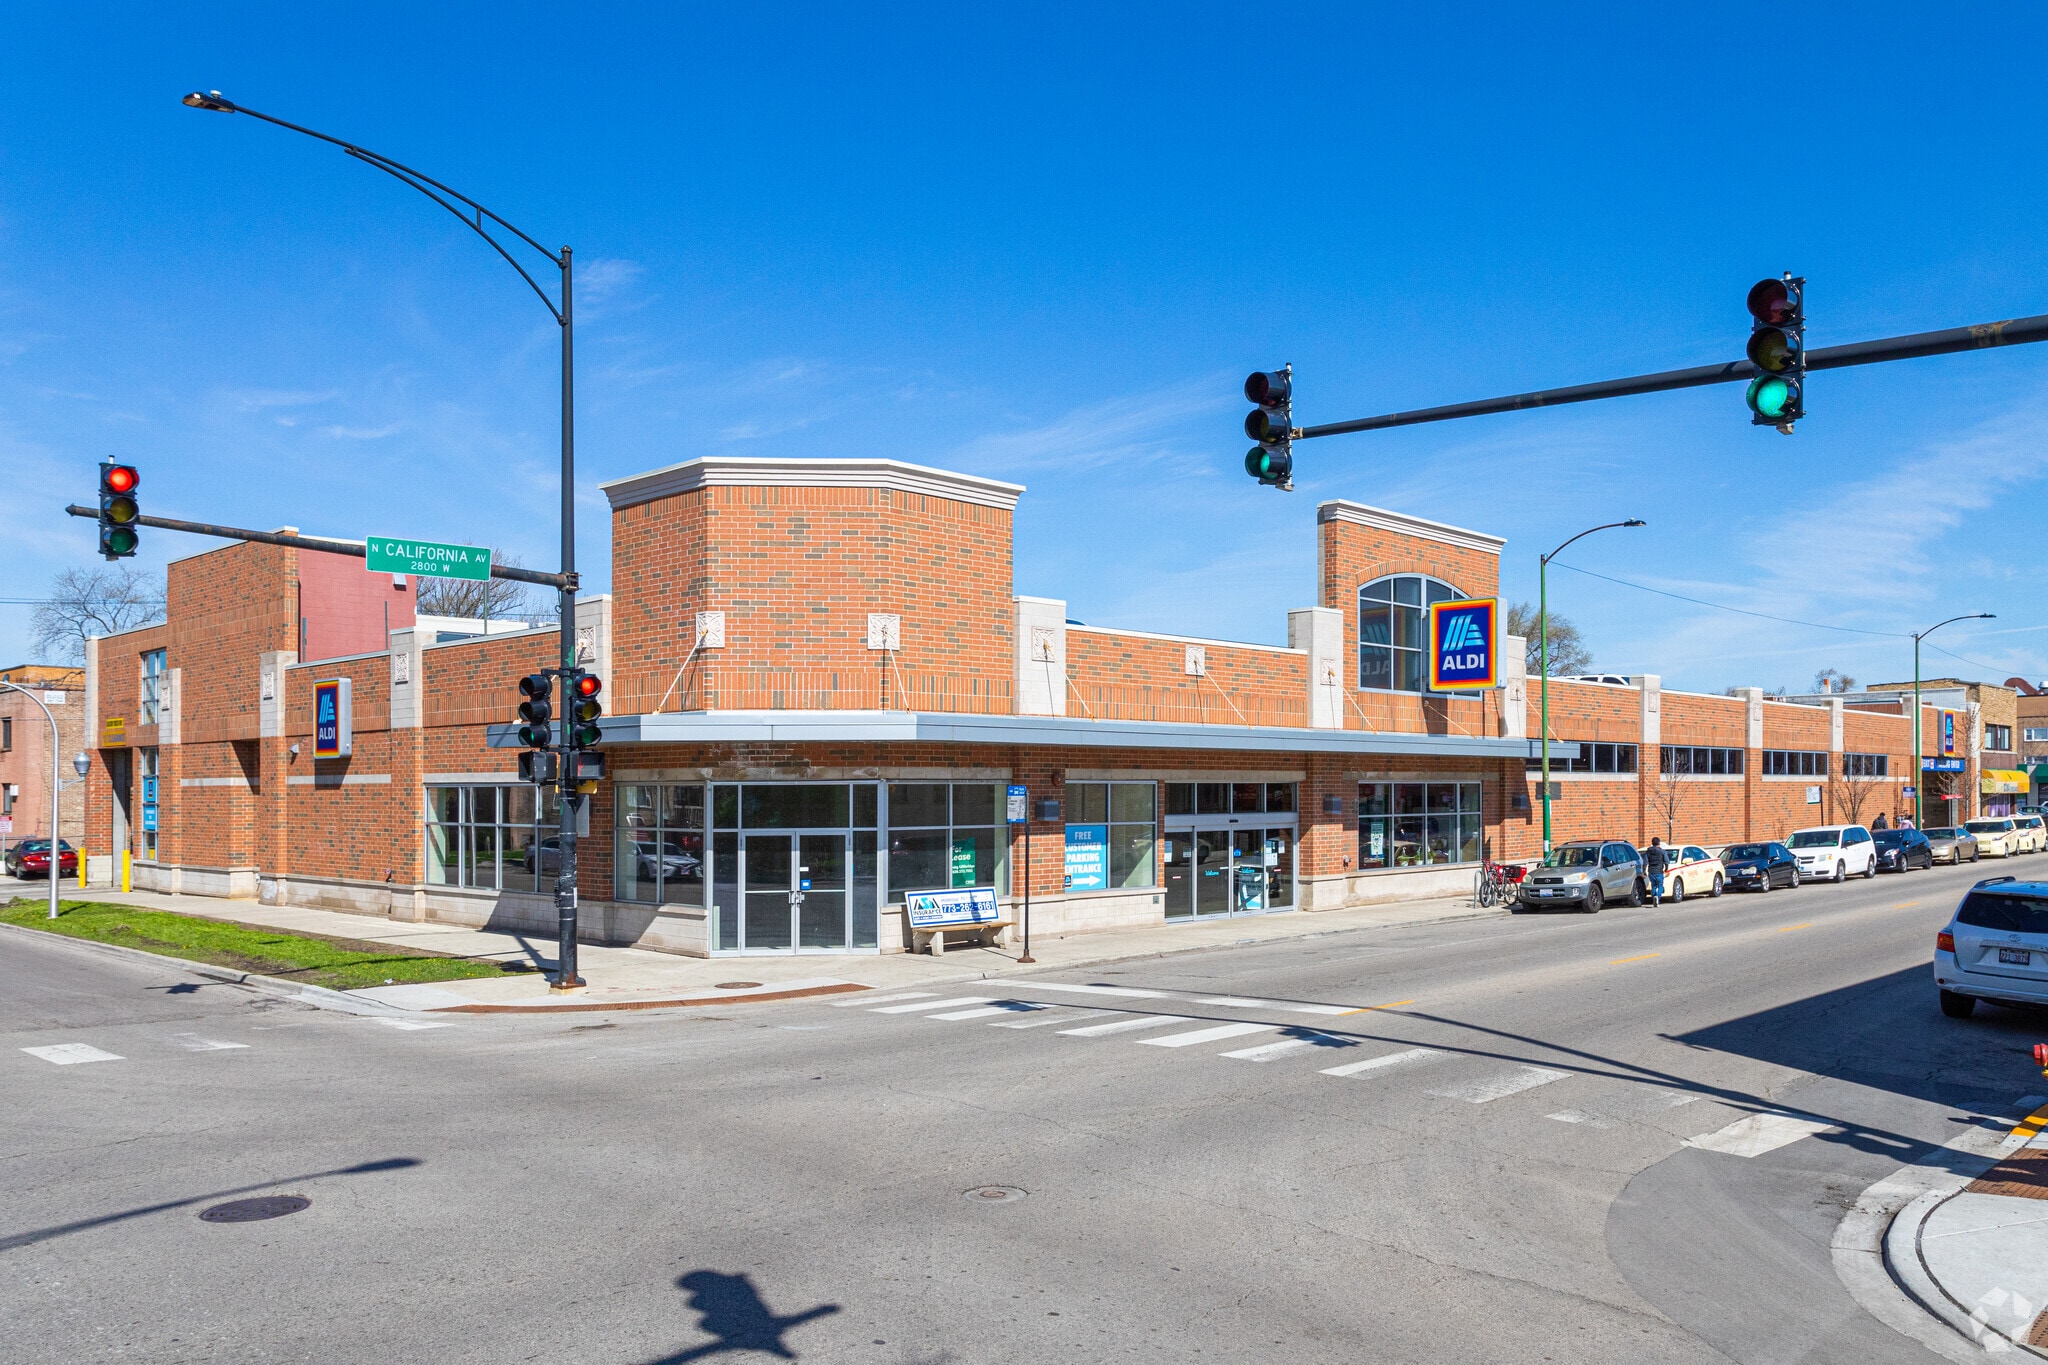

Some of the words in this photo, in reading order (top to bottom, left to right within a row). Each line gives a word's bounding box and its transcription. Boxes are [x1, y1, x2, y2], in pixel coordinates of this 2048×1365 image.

[371, 543, 379, 553] N
[385, 543, 468, 563] CALIFORNIA
[474, 554, 487, 563] AV
[410, 561, 437, 572] 2800
[442, 564, 451, 573] W
[1442, 653, 1485, 671] ALDI
[318, 727, 336, 740] ALDI
[1074, 831, 1092, 840] FREE
[1066, 852, 1100, 863] PARKING
[1065, 863, 1102, 874] ENTRANCE
[913, 908, 942, 916] INSURANCE
[942, 901, 994, 913] 773-262-6161
